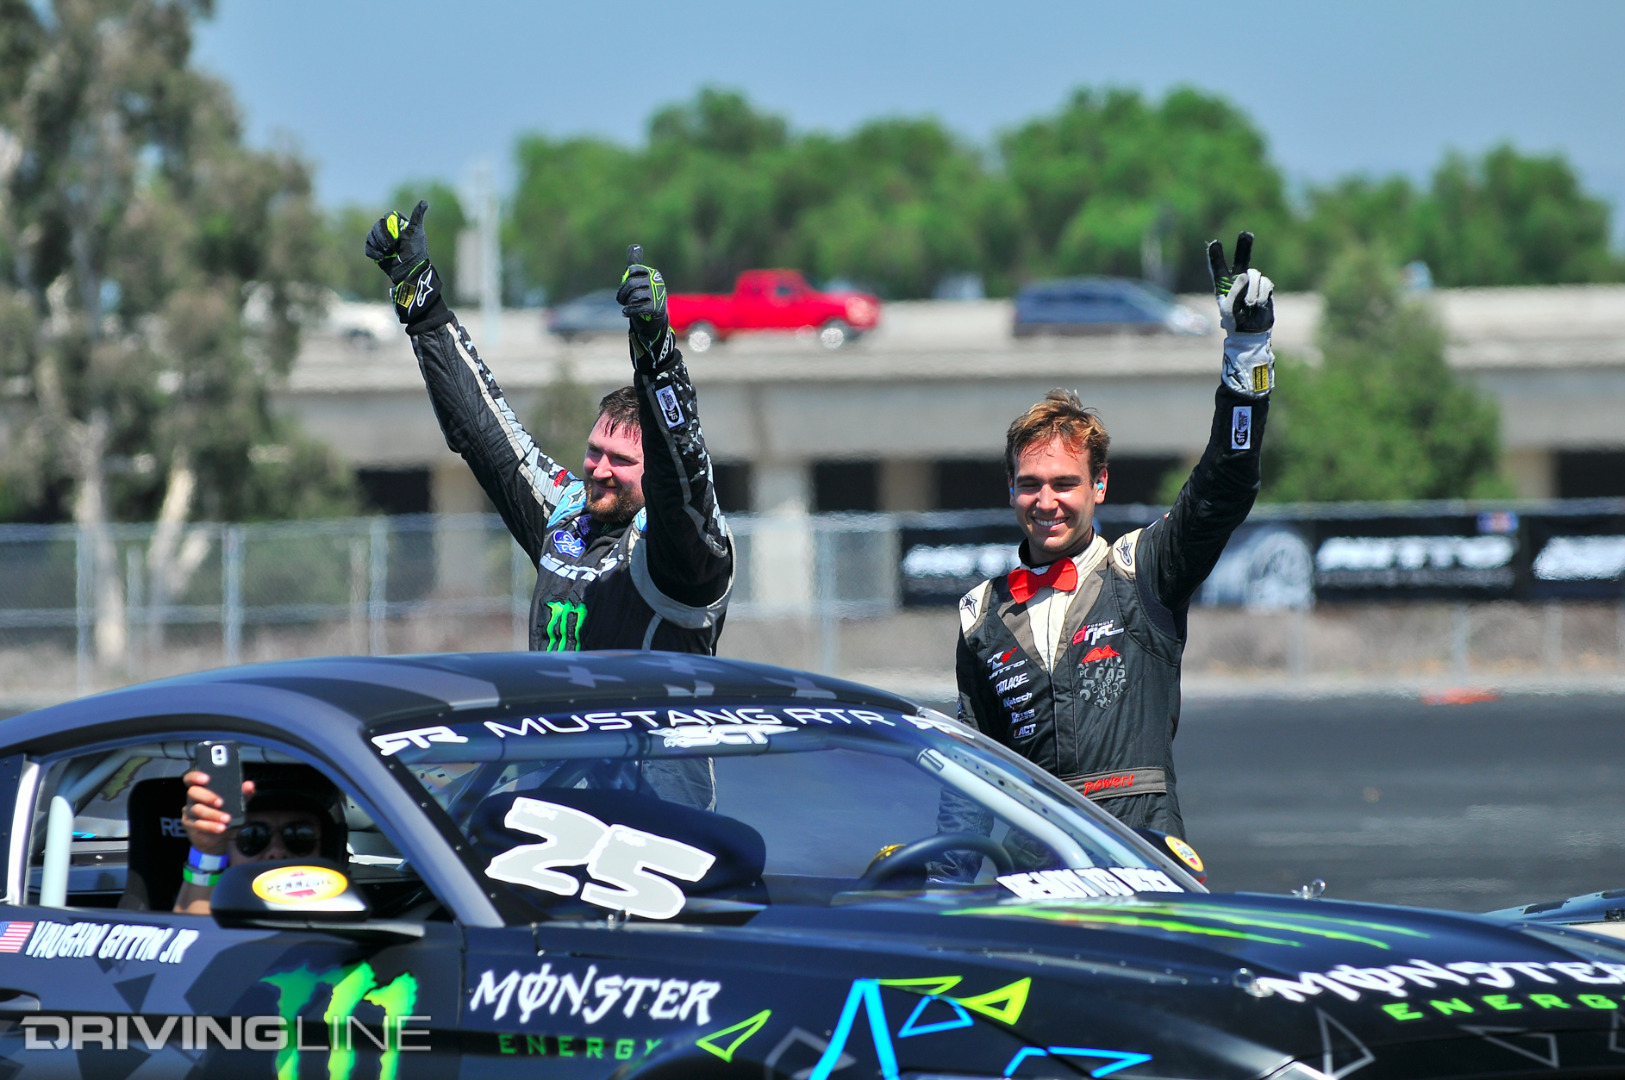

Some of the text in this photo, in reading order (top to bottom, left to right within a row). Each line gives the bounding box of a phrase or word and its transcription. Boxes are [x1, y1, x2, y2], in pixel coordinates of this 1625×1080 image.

[484, 707, 783, 739] MUSTANG
[783, 708, 896, 727] RTR
[485, 796, 716, 920] 25
[25, 920, 200, 964] VAUGHN GITTIN JR
[1381, 993, 1625, 1021] ENERG
[498, 1032, 663, 1061] ENERGY
